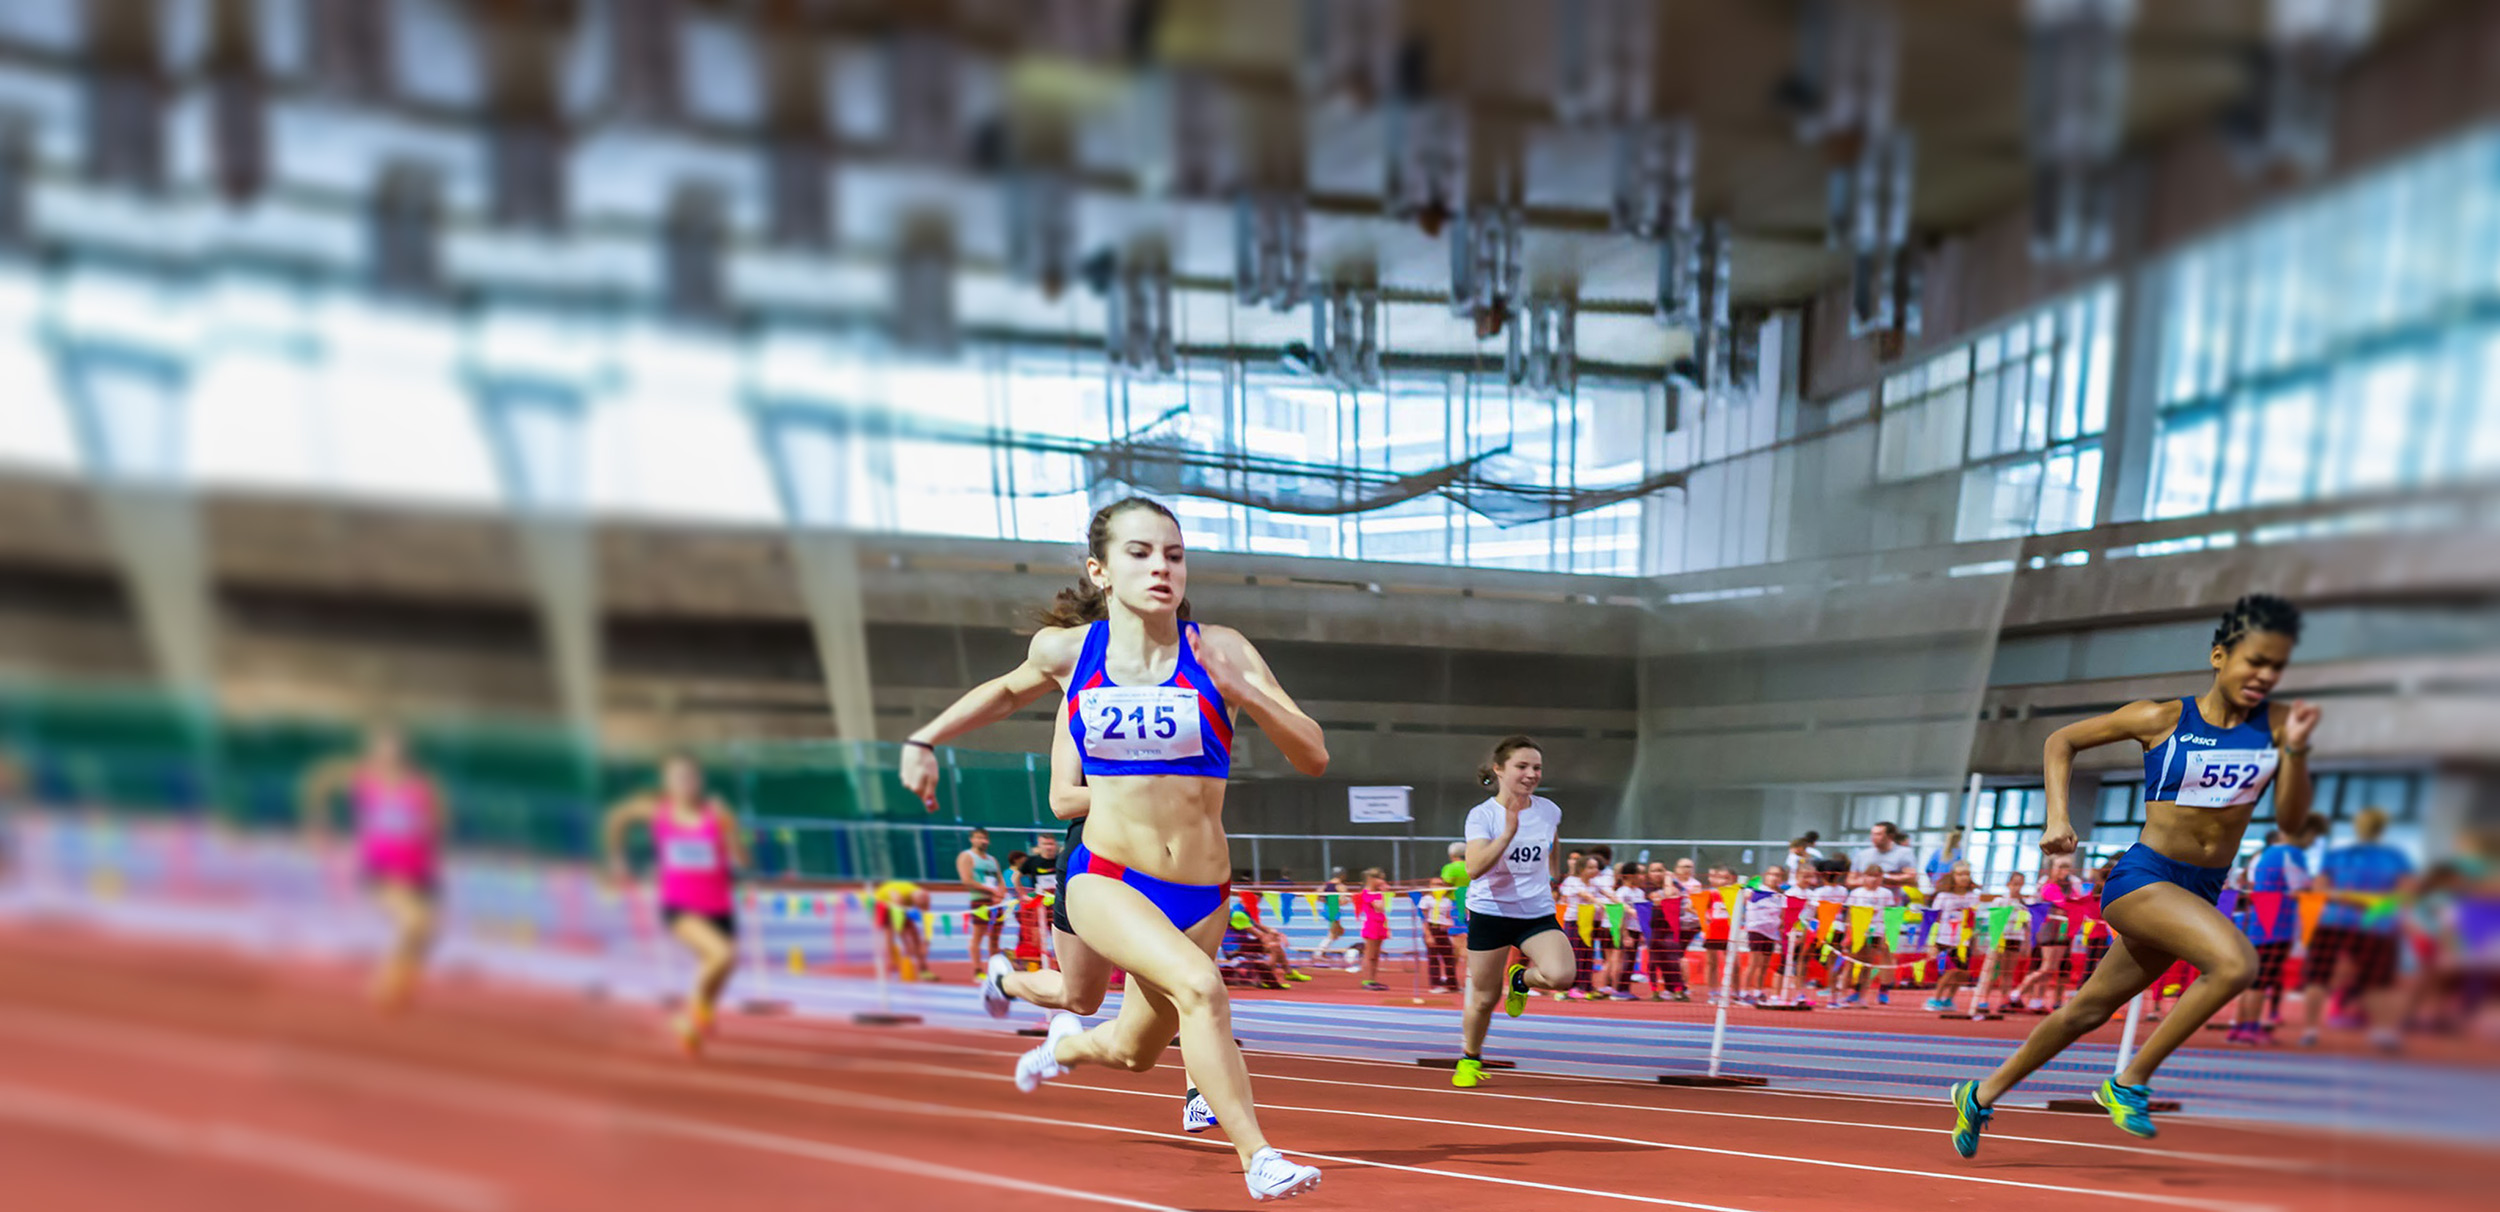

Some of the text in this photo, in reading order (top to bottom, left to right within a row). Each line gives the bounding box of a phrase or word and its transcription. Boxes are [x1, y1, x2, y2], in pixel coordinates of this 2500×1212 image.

[1101, 706, 1177, 739] 215
[2199, 764, 2260, 789] 552
[1509, 846, 1541, 863] 492
